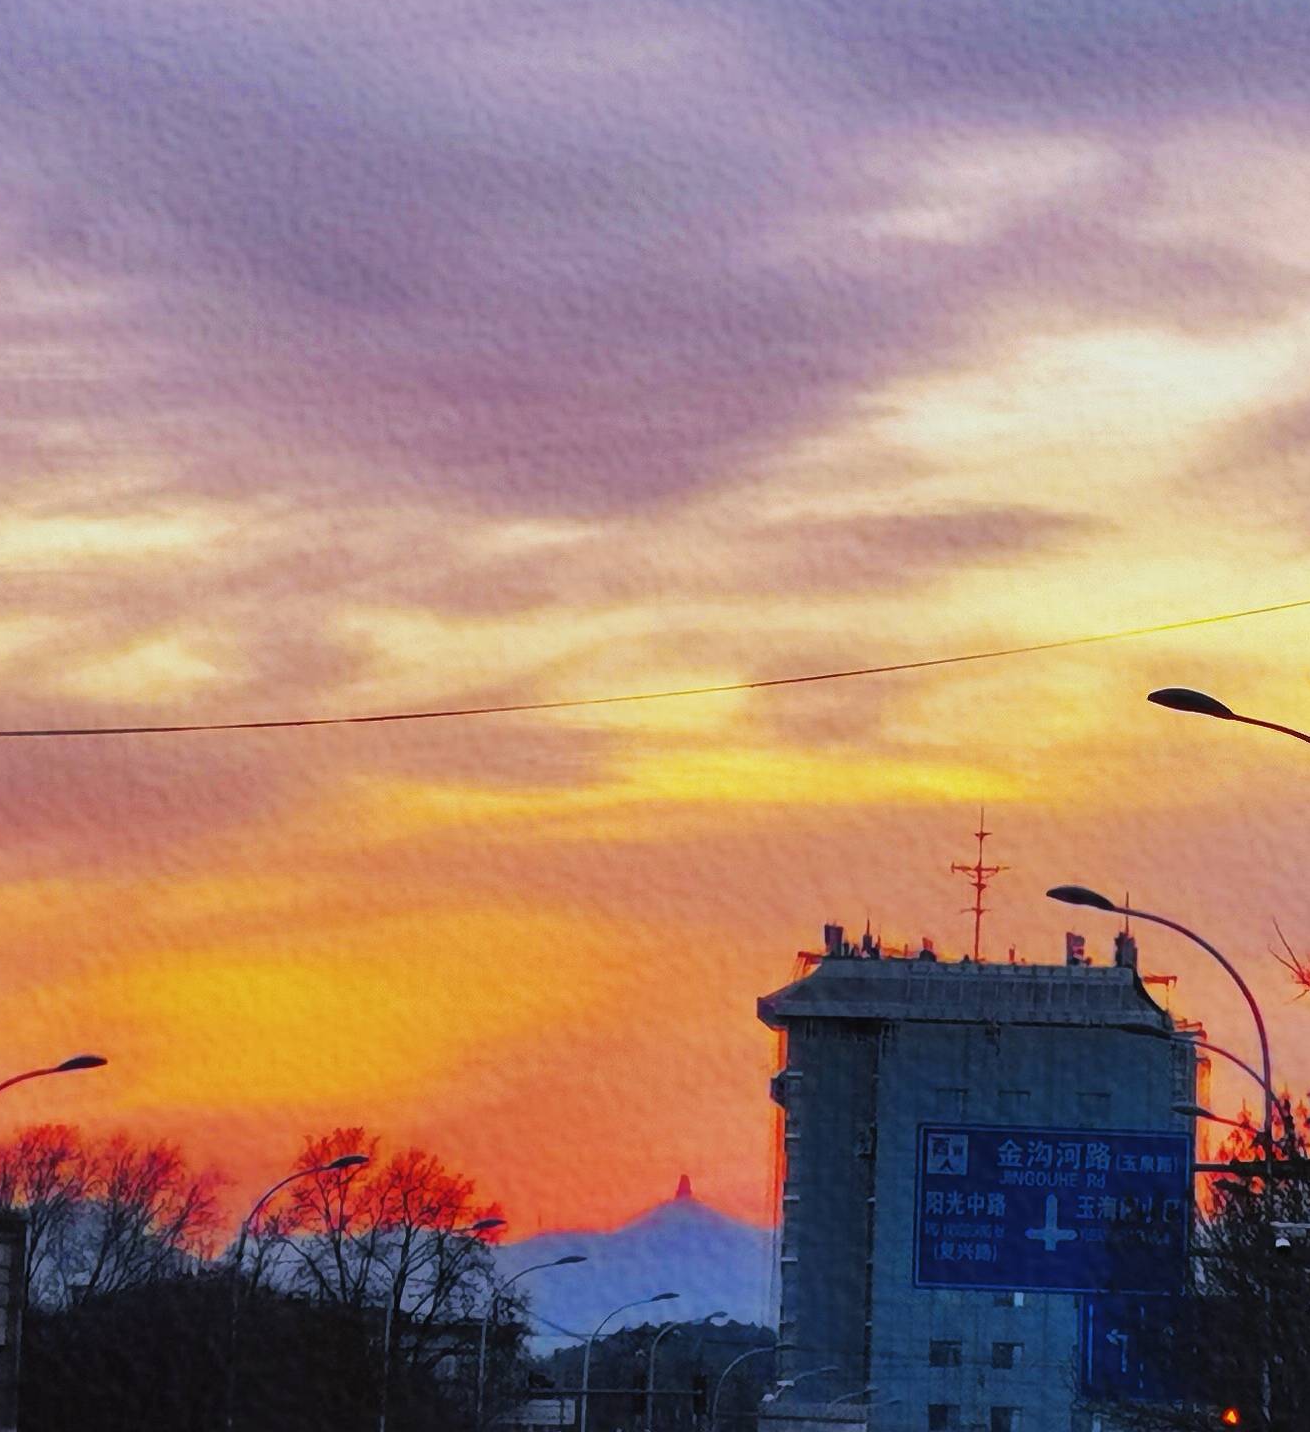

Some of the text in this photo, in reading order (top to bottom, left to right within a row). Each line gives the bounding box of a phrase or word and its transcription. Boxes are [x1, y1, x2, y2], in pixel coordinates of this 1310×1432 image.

[997, 1139, 1111, 1170] 金沟河路
[999, 1170, 1078, 1187] JINGOUHE
[925, 1191, 1007, 1216] 阳光中路
